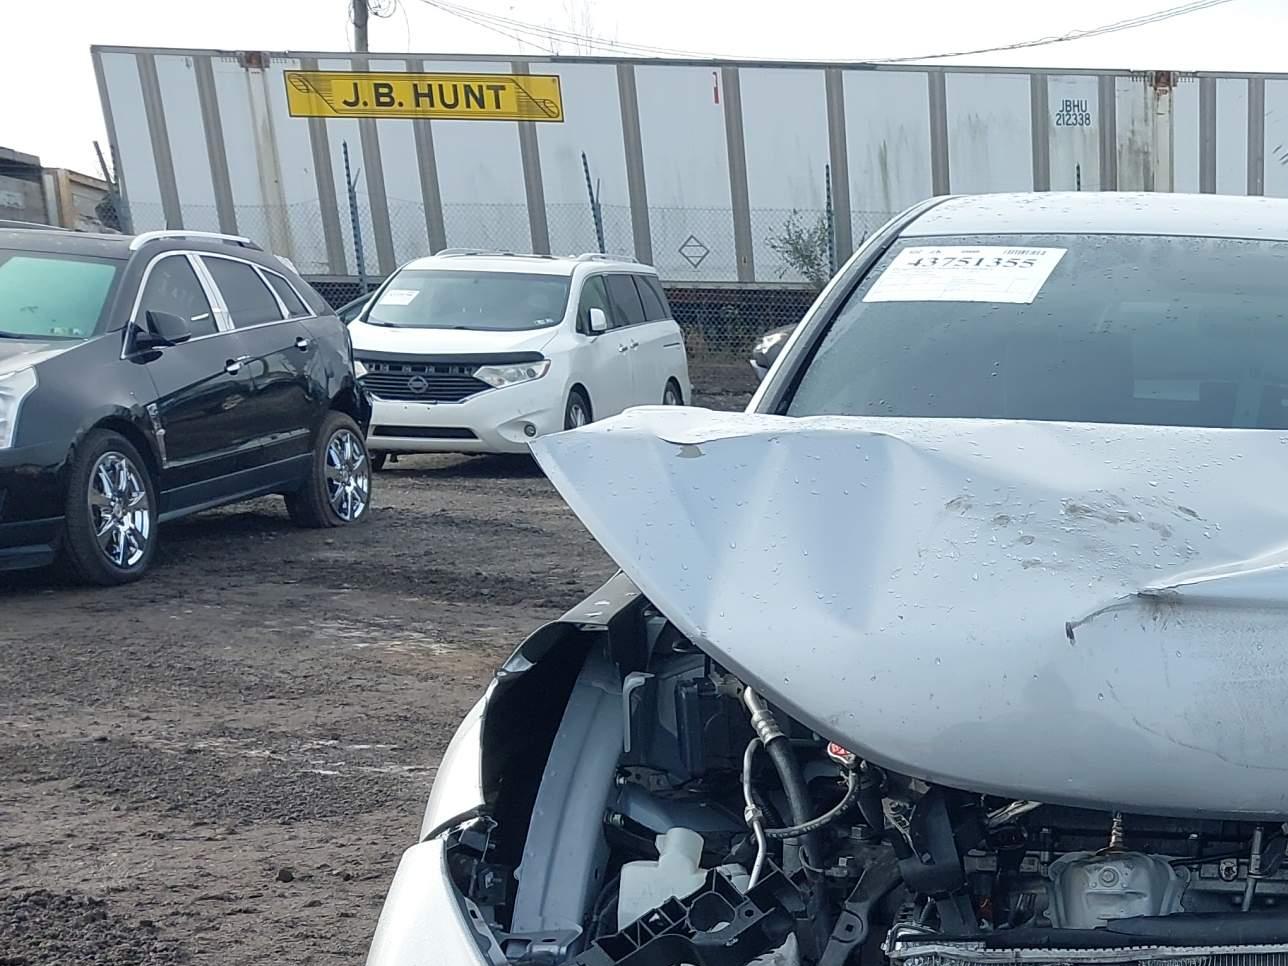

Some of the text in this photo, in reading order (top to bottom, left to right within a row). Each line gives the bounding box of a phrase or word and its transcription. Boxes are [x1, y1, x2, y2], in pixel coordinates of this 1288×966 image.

[341, 81, 507, 110] J.B. HUNT
[1058, 99, 1088, 113] JBHU
[1055, 112, 1092, 126] 212338
[907, 256, 1038, 269] 43751355
